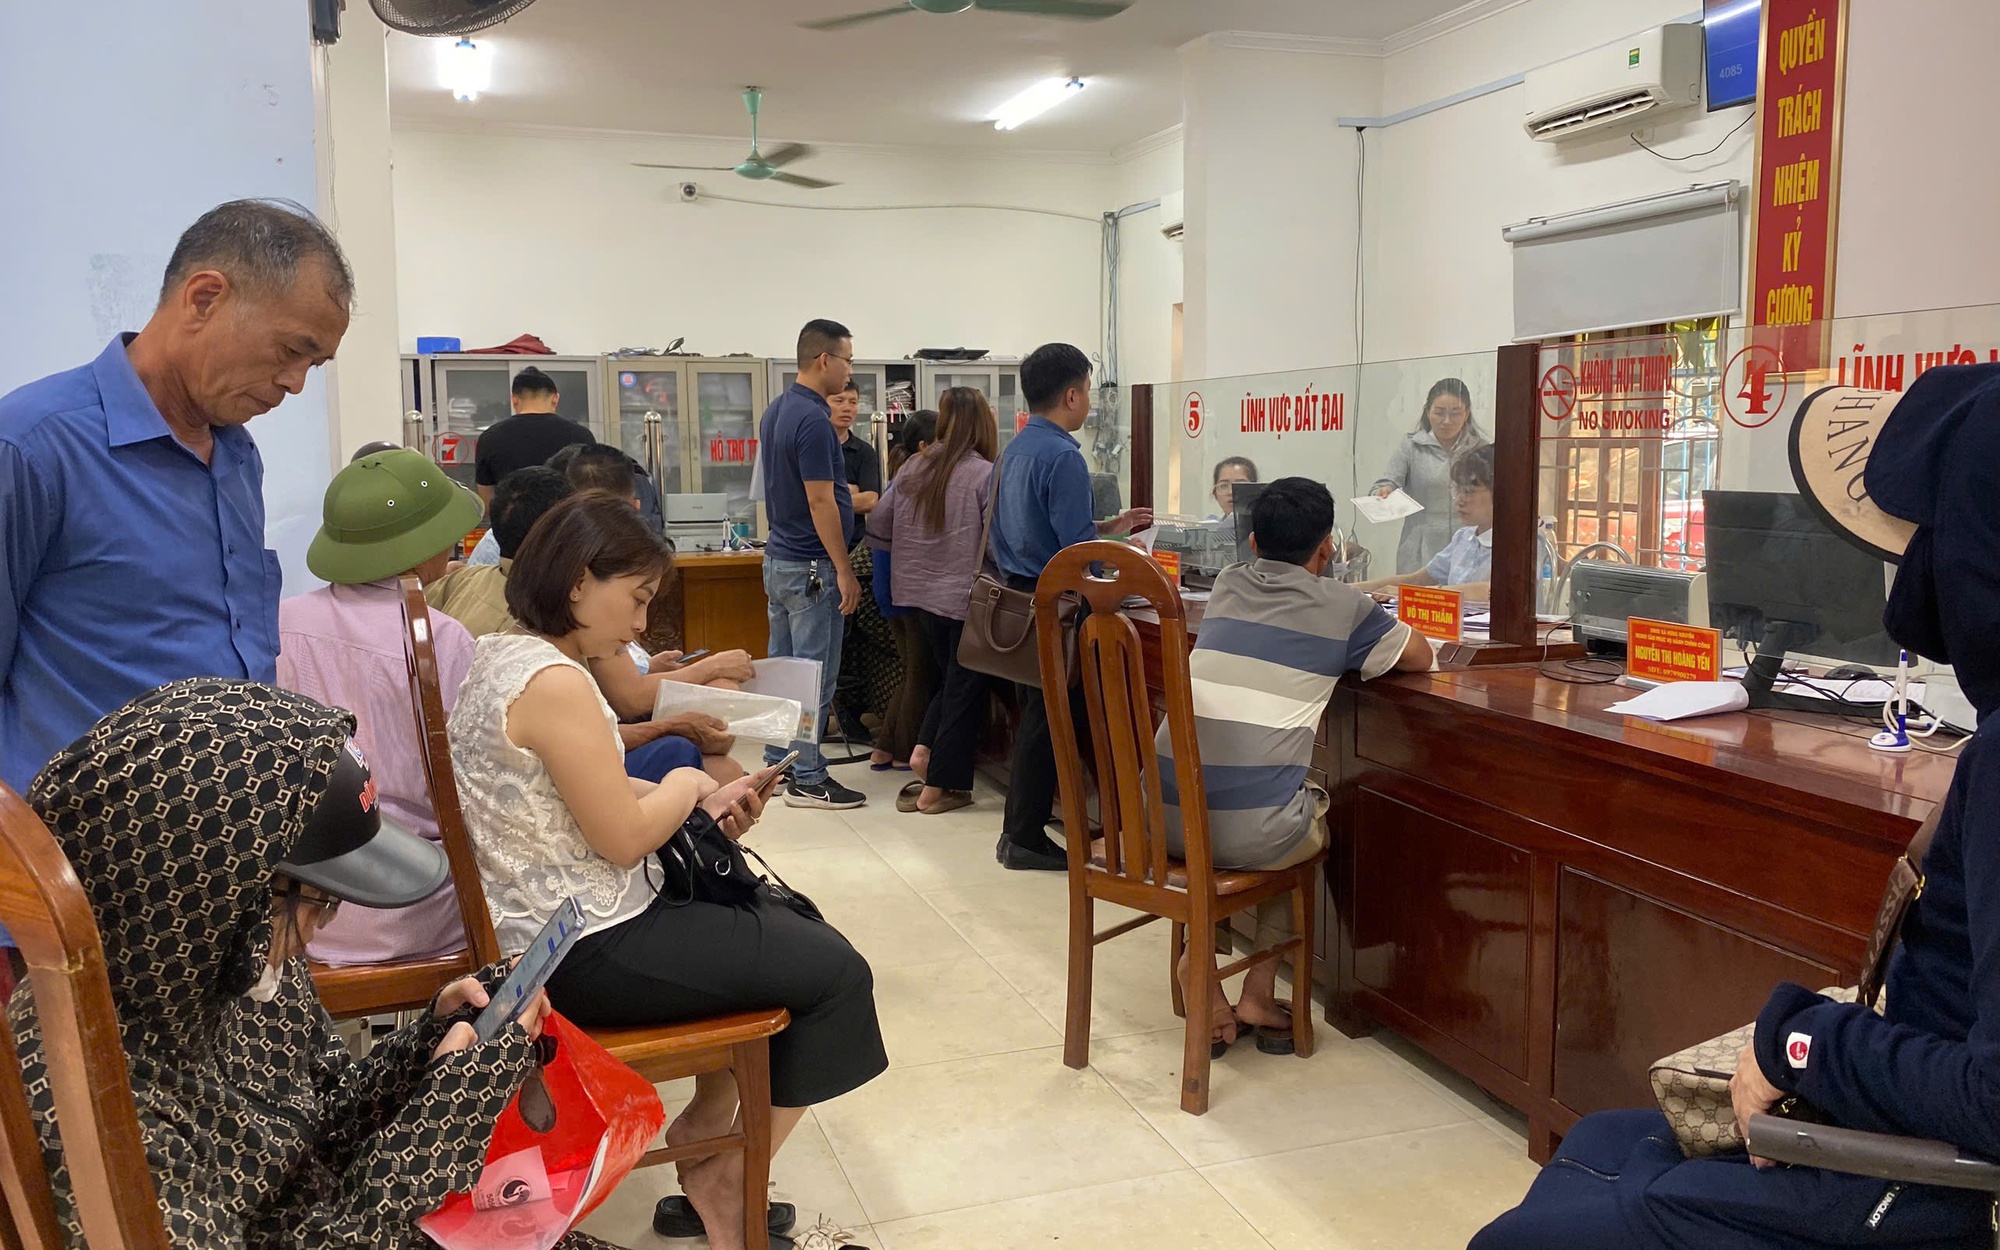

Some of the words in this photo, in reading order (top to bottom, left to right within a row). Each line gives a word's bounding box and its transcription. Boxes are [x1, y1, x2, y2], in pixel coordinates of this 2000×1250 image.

[1779, 8, 1826, 75] QUYỀN
[1719, 63, 1743, 79] 4085
[1777, 84, 1822, 138] TRÁCH
[1773, 153, 1820, 210] NHIỆM
[1782, 215, 1802, 272] KỶ
[1766, 283, 1813, 327] CƯƠNG
[1580, 352, 1614, 394] KHÔNG
[1616, 350, 1636, 393] HÚT
[1638, 342, 1673, 392] THUỐC
[1736, 360, 1773, 415] 4
[1188, 400, 1200, 432] 5
[1240, 391, 1266, 433] LĨNH
[1268, 393, 1291, 440] VỰC
[1294, 382, 1319, 432] ĐẤT
[1321, 393, 1344, 431] ĐAI
[1578, 410, 1599, 430] NO
[1601, 408, 1670, 430] SMOKING
[441, 438, 460, 461] 7
[1417, 608, 1430, 623] THỊ
[1661, 649, 1672, 667] THỊ
